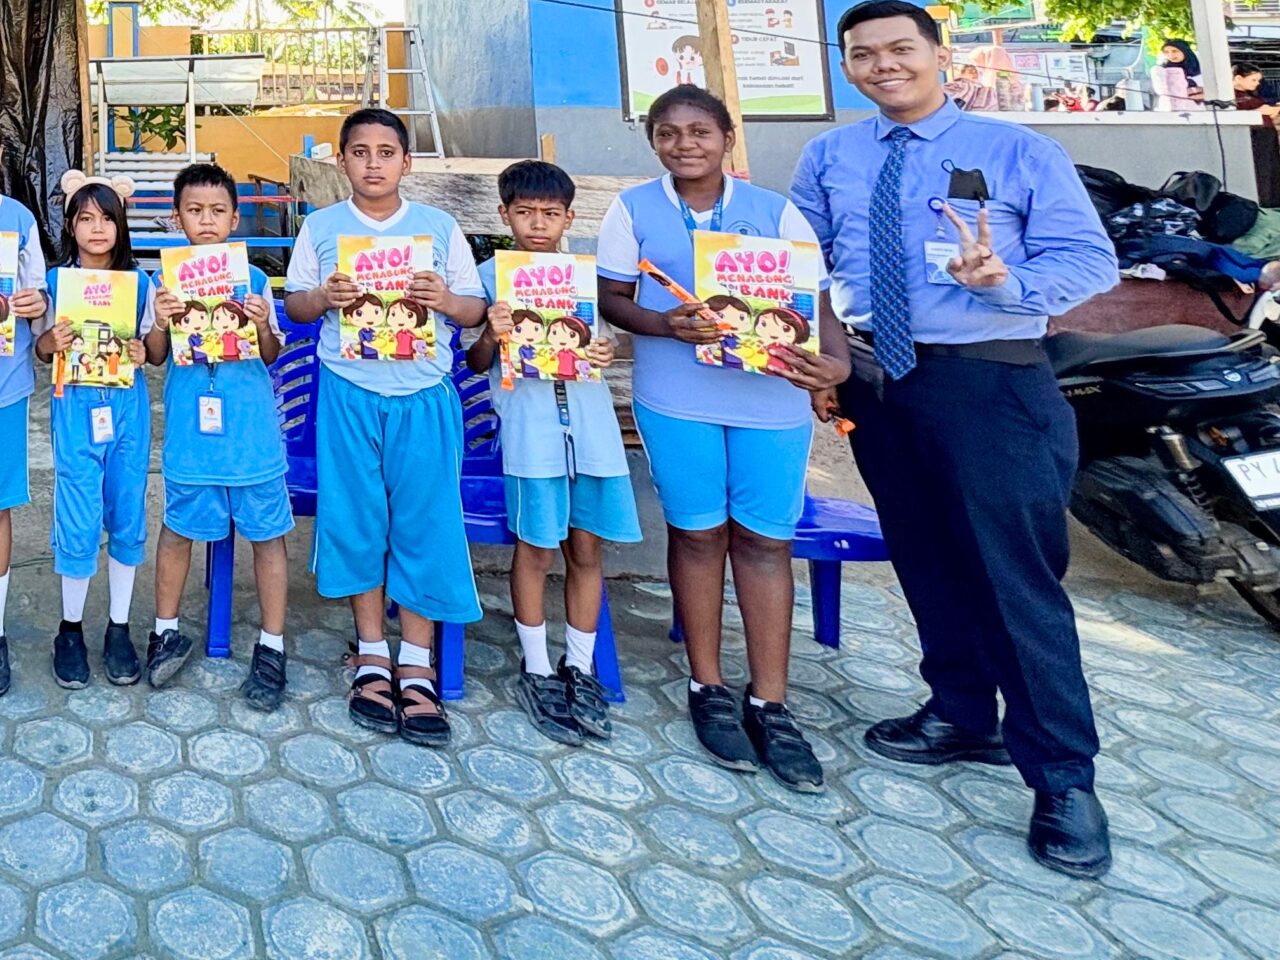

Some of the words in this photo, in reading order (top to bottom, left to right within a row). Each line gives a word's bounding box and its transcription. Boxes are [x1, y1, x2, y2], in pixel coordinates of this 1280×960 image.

[178, 252, 227, 282] AYO!
[355, 244, 411, 273] AYO!
[714, 249, 789, 274] AYO!
[180, 271, 233, 290] MENABUNG
[356, 266, 414, 281] MENABUNG
[513, 263, 573, 288] AYO!
[716, 273, 793, 284] MENABUNG
[83, 282, 112, 296] AYO!
[197, 284, 232, 297] BANK
[514, 286, 577, 298] MENABUNG
[739, 284, 791, 301] BANK
[533, 297, 575, 310] BANK
[1237, 461, 1268, 482] PY
